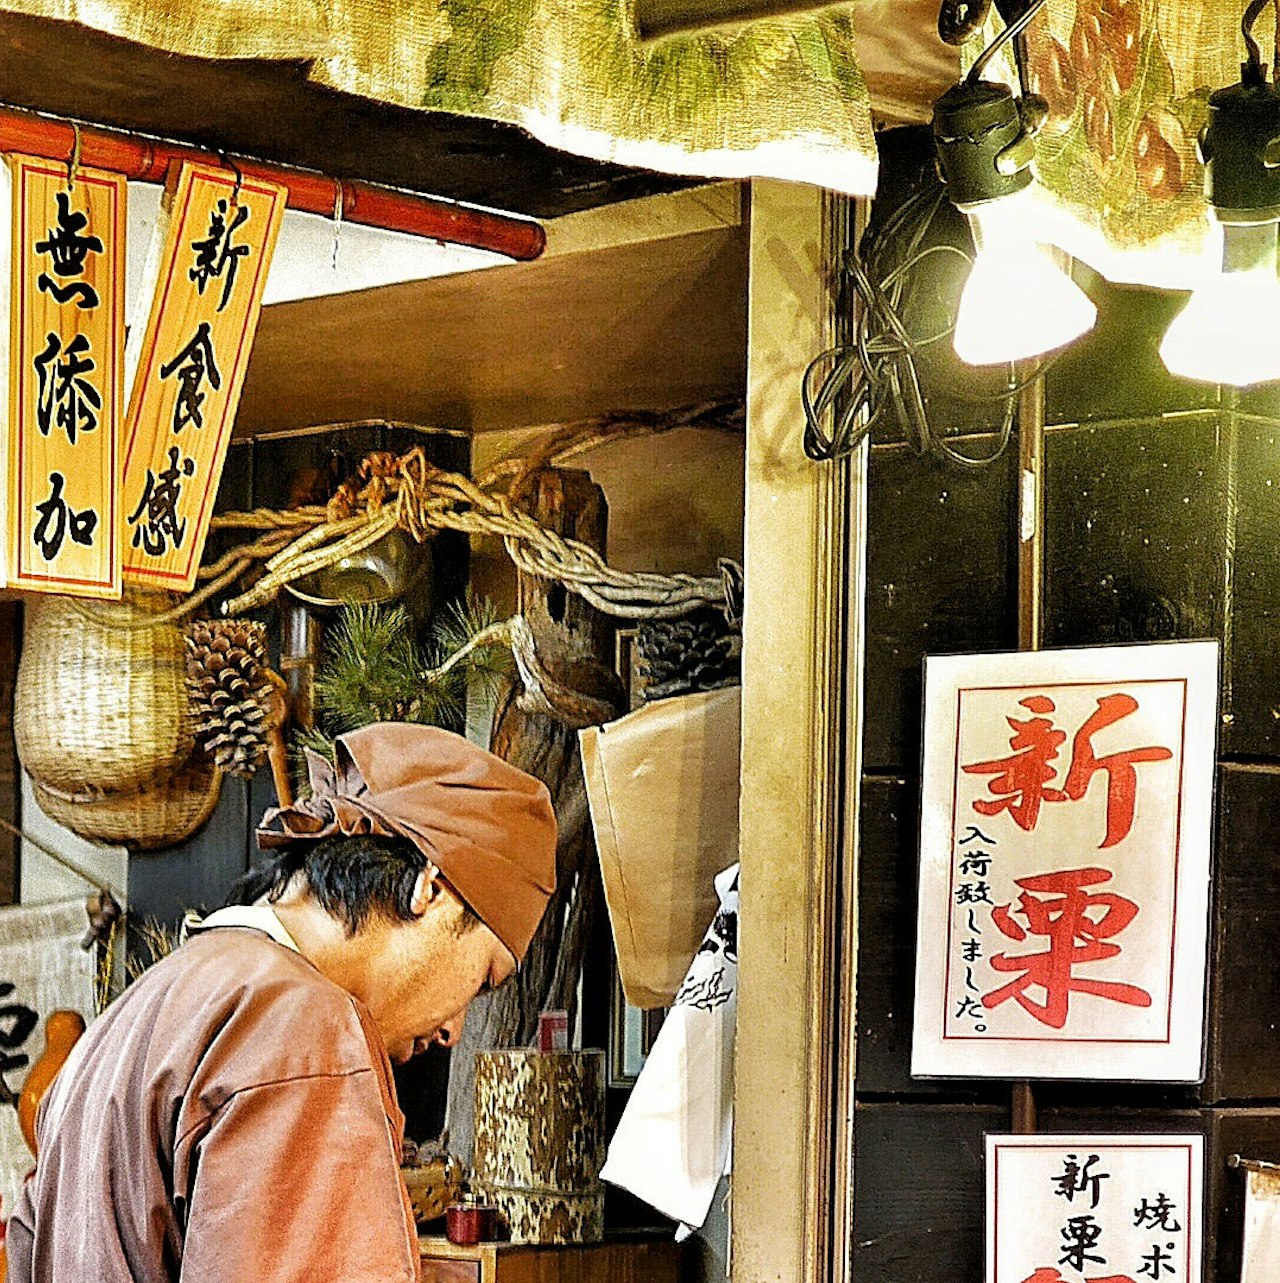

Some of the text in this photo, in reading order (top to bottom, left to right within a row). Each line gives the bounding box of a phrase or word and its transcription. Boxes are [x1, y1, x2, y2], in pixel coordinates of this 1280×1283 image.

[33, 192, 103, 560] 無添加
[128, 200, 250, 557] 新食感
[954, 826, 996, 1034] 入荷致しました。
[961, 693, 1173, 1029] 新栗
[1050, 1153, 1110, 1273] 新栗
